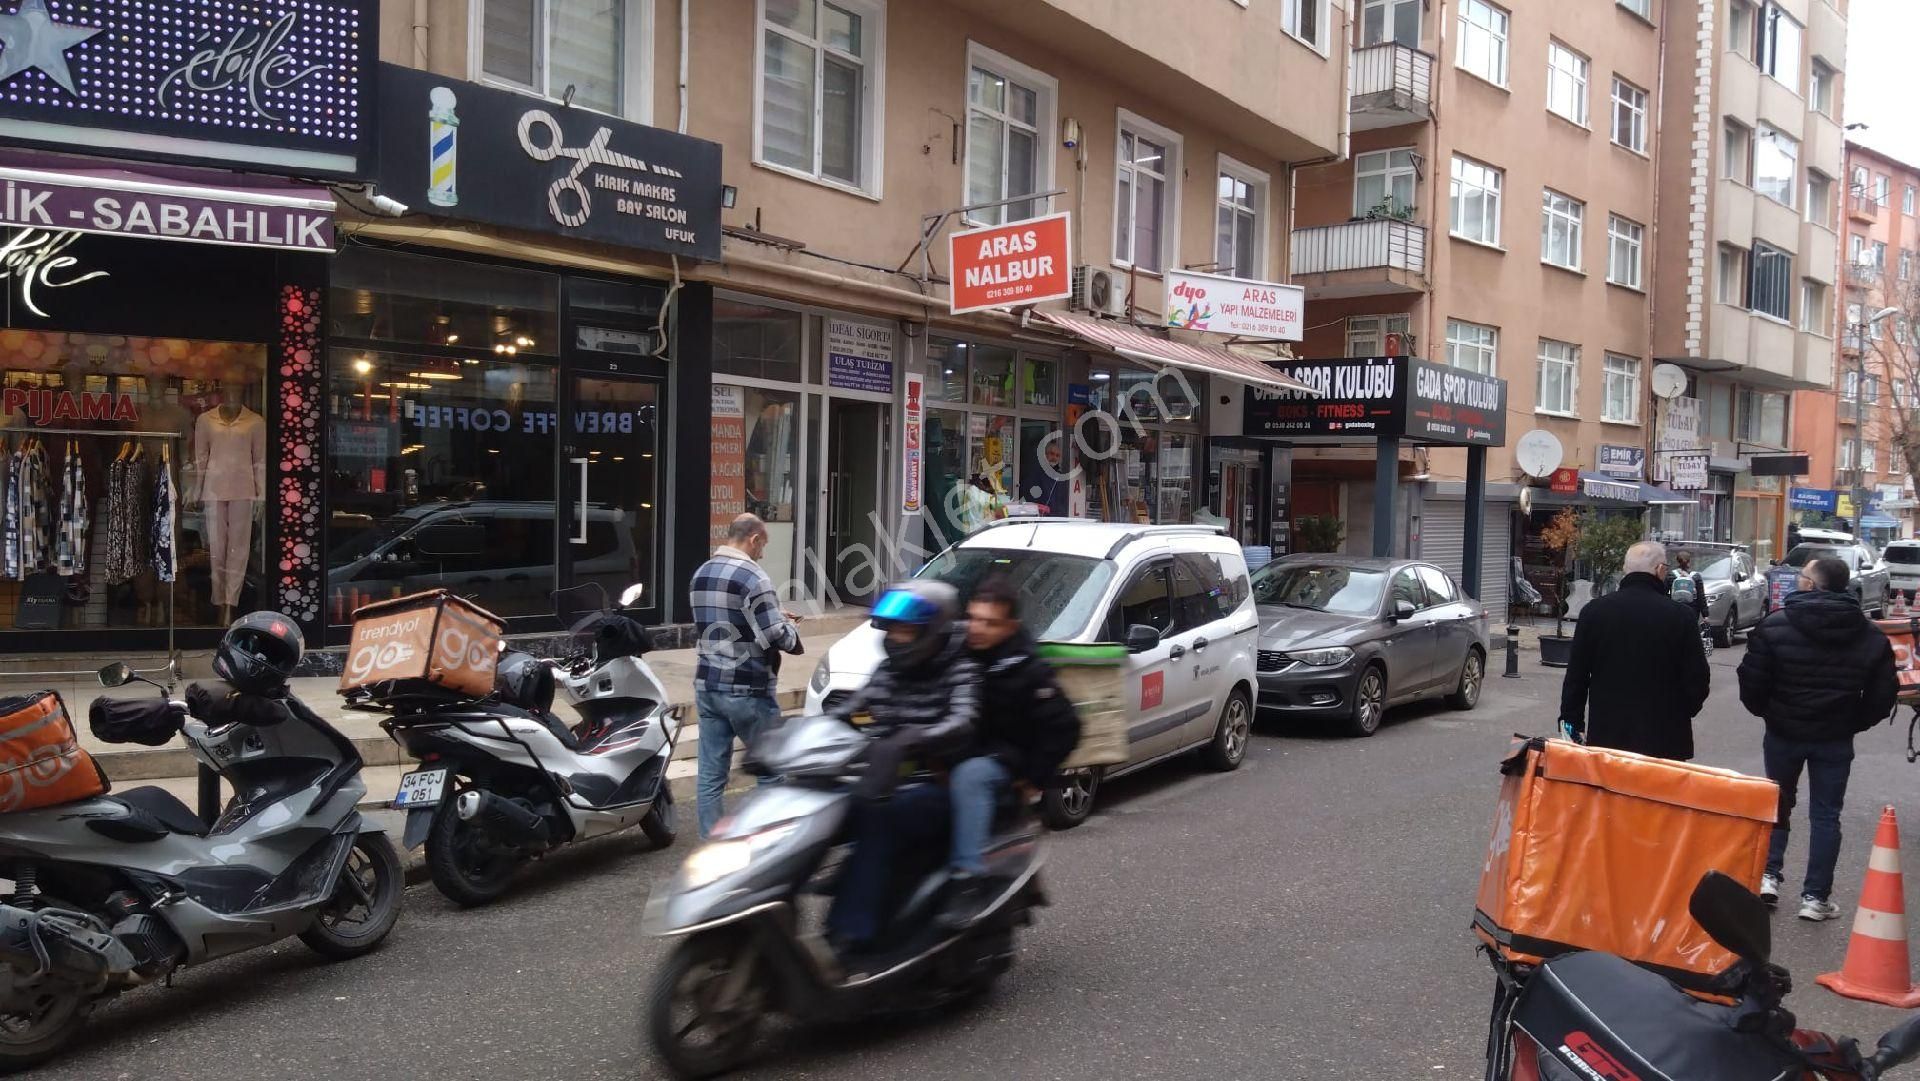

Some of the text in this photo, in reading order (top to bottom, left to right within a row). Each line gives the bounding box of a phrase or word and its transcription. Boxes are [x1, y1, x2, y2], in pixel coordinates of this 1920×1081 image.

[594, 173, 676, 202] KIRIK MAKAS
[0, 181, 54, 225] İK
[616, 199, 687, 225] BAY SALON
[665, 228, 696, 244] UFUK
[978, 230, 1037, 260] ARAS
[965, 255, 1055, 288] NALBUR
[1173, 281, 1206, 304] dyo
[1242, 287, 1276, 305] ARAS
[1220, 303, 1297, 323] YAPI MALZEMELERİ
[1334, 357, 1395, 399] KULÜBÜ
[1416, 366, 1499, 411] GADA SPOR KULÜBÜ
[1317, 404, 1365, 419] FITNESS
[1610, 448, 1632, 461] EMİR
[360, 616, 420, 641] trendyol
[404, 771, 443, 788] 34 FCJ
[411, 787, 432, 801] 051
